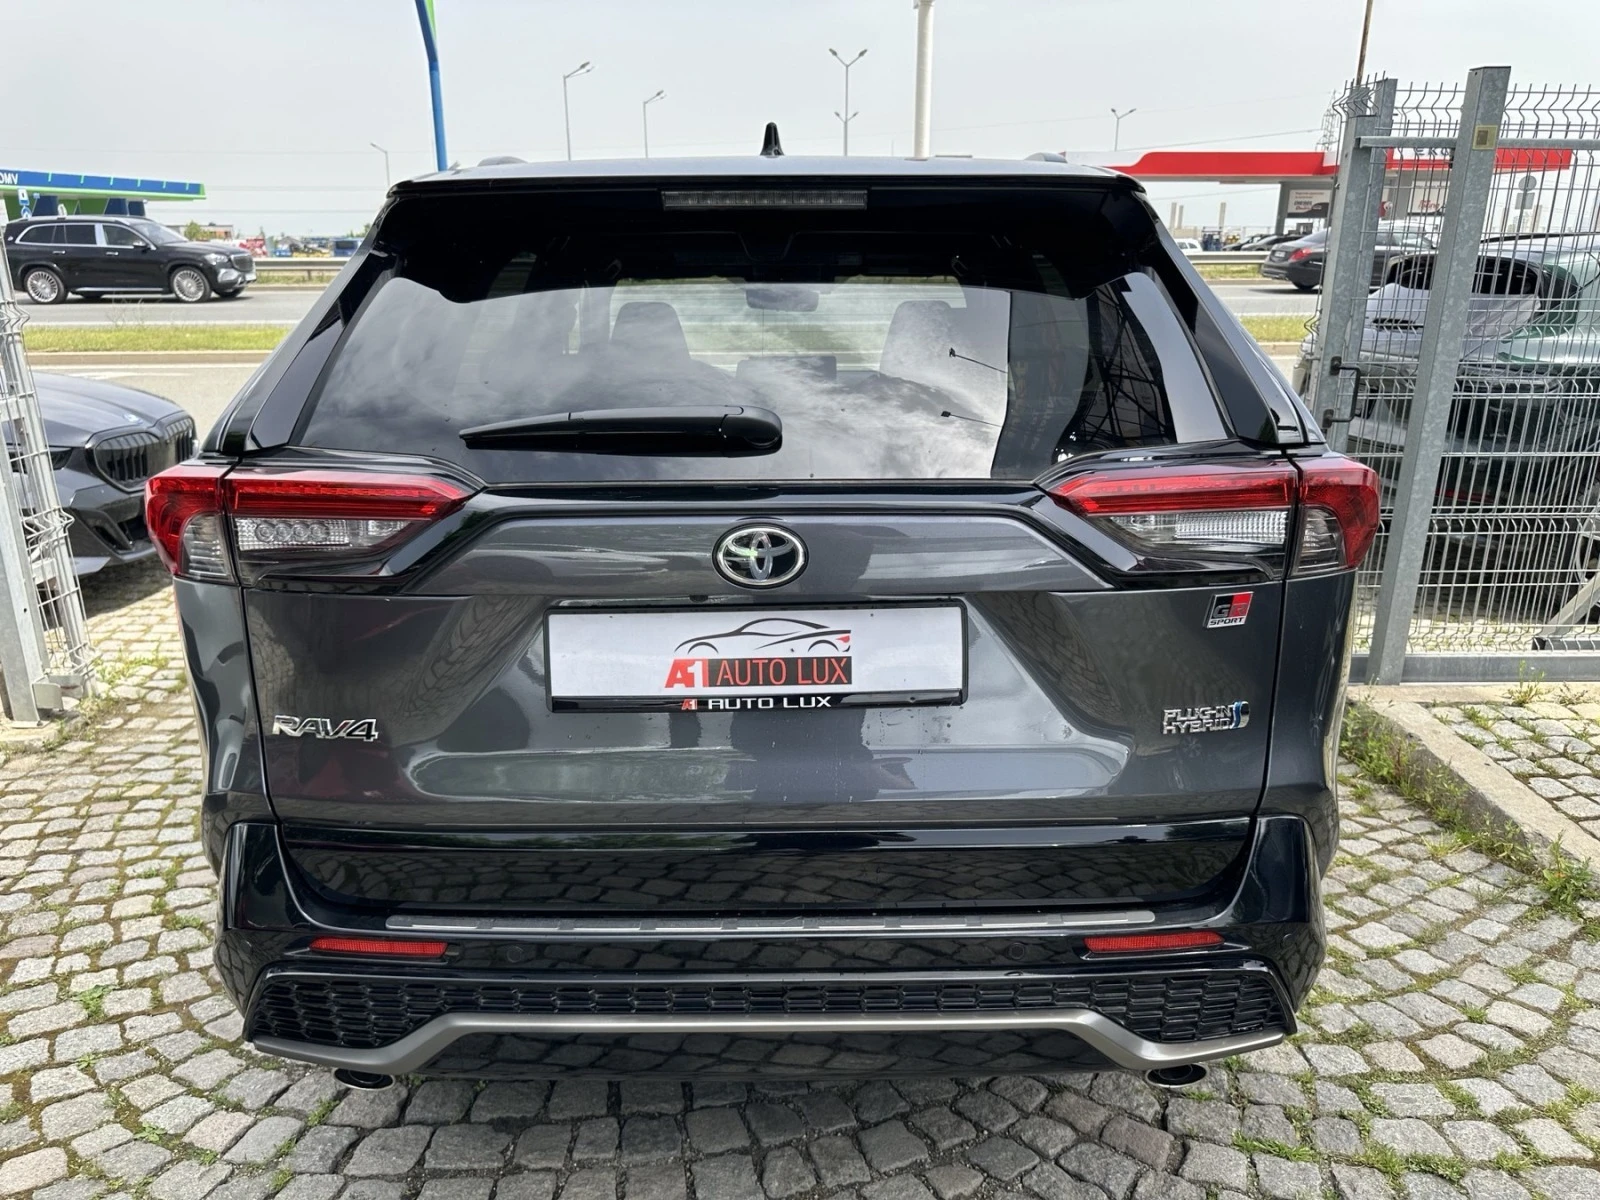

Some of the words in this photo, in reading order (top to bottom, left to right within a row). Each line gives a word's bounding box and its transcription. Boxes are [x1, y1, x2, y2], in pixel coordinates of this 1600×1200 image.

[1213, 603, 1247, 618] GR
[1210, 617, 1245, 626] SPORT
[664, 658, 709, 688] A1
[716, 658, 787, 686] AUTO
[797, 657, 848, 685] LUX
[707, 698, 774, 710] AUTO
[783, 696, 832, 709] LUX
[1163, 705, 1234, 721] PLUG-IN
[272, 715, 379, 742] RAV4
[1162, 717, 1233, 735] HYBRID
